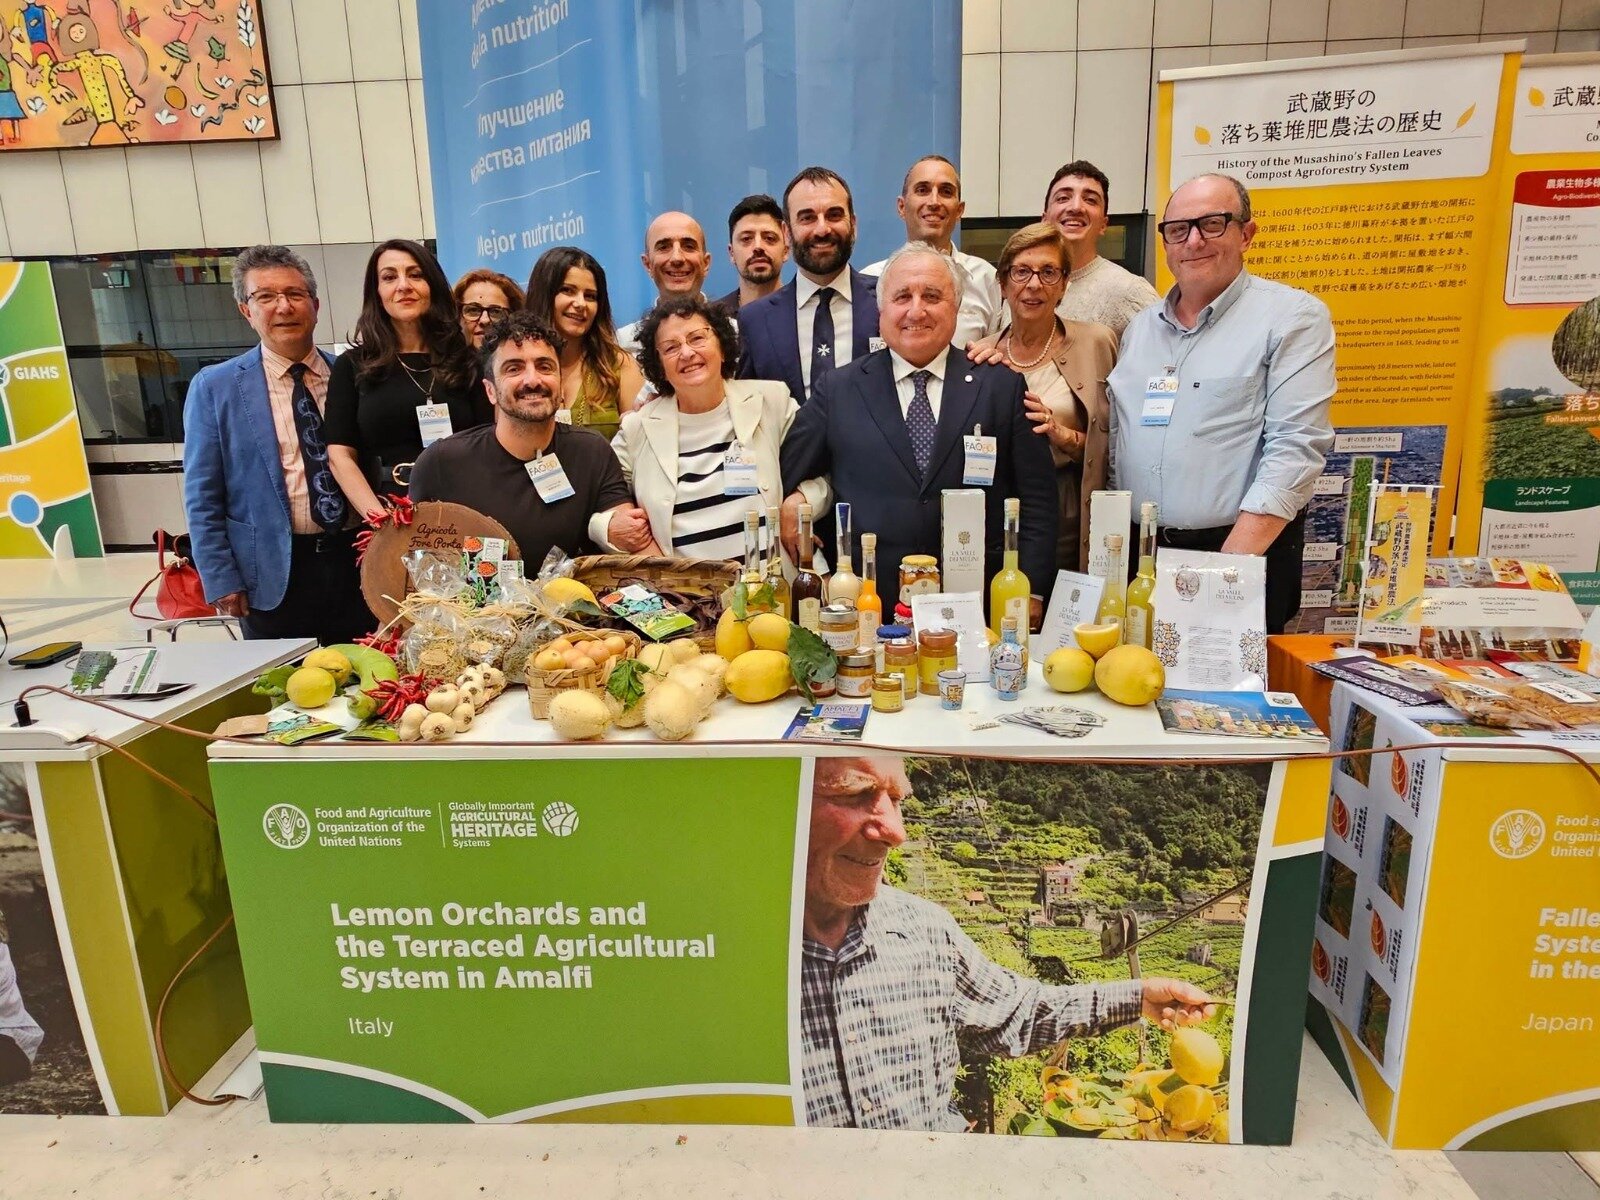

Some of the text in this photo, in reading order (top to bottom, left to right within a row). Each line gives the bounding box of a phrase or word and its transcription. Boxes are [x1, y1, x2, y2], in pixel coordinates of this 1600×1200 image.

[491, 0, 569, 48] nutrition
[1286, 89, 1376, 114] 武蔵野の
[1552, 86, 1600, 107] 武蔵
[1221, 109, 1442, 145] 落ち葉堆肥農法の歴史
[528, 119, 591, 162] питания
[1217, 147, 1442, 170] History of the Musashino's Fallen Leaves
[1246, 162, 1409, 181] Compost Agroforestry System
[522, 210, 584, 250] nutrición
[1401, 327, 1436, 336] population
[1342, 340, 1385, 350] headquarters
[13, 365, 60, 380] GIAHS
[1516, 485, 1572, 496] ランドスケープ
[417, 523, 458, 538] Agricola
[314, 806, 432, 820] Food and Agriculture
[448, 801, 535, 812] Globally Important
[450, 812, 536, 822] AGRICULTURAL
[1555, 814, 1588, 826] Food
[317, 821, 425, 835] Organization of the
[451, 823, 538, 838] HERITAGE
[319, 835, 402, 847] United Nations
[453, 839, 491, 849] Systems
[1553, 830, 1600, 844] Organi
[1551, 846, 1595, 857] United
[331, 901, 647, 927] Lemon Orchards and
[335, 933, 715, 962] the Terraced Agricultural
[1529, 959, 1600, 979] in the
[340, 965, 593, 993] System in Amalfi
[348, 1016, 394, 1038] Italy
[1520, 1012, 1594, 1034] Japan
